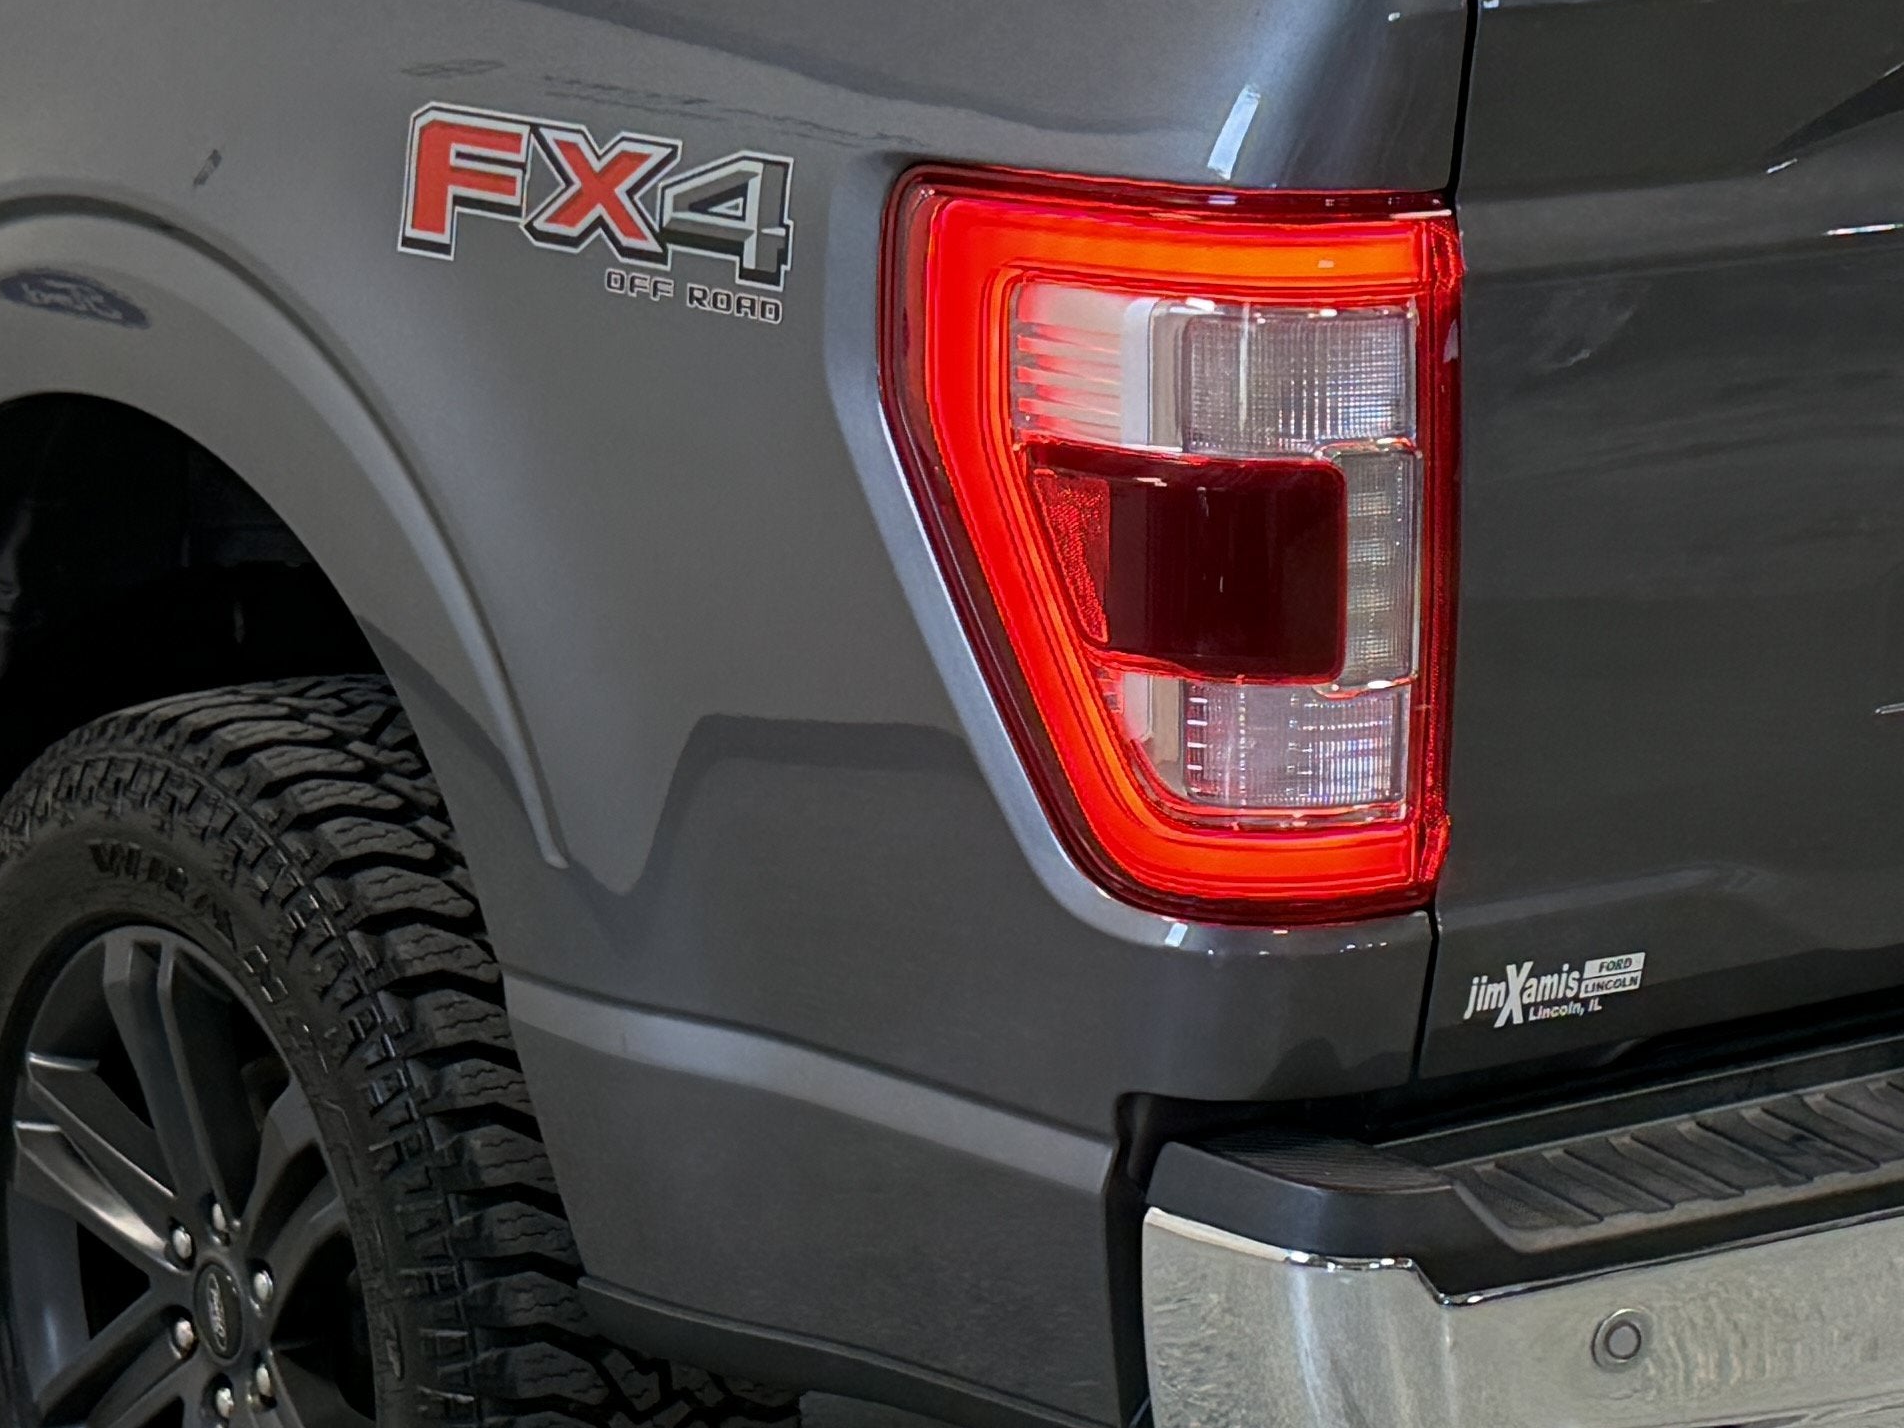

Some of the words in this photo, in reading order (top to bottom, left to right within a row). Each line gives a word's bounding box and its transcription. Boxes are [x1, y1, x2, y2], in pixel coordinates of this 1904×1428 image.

[398, 101, 794, 292] FX4
[604, 267, 675, 302] OFF
[685, 283, 784, 326] ROAD
[1599, 956, 1634, 973] FORD
[1583, 974, 1640, 995] LINCOLN
[1528, 999, 1586, 1022] Lincoln,
[1587, 996, 1603, 1013] IL
